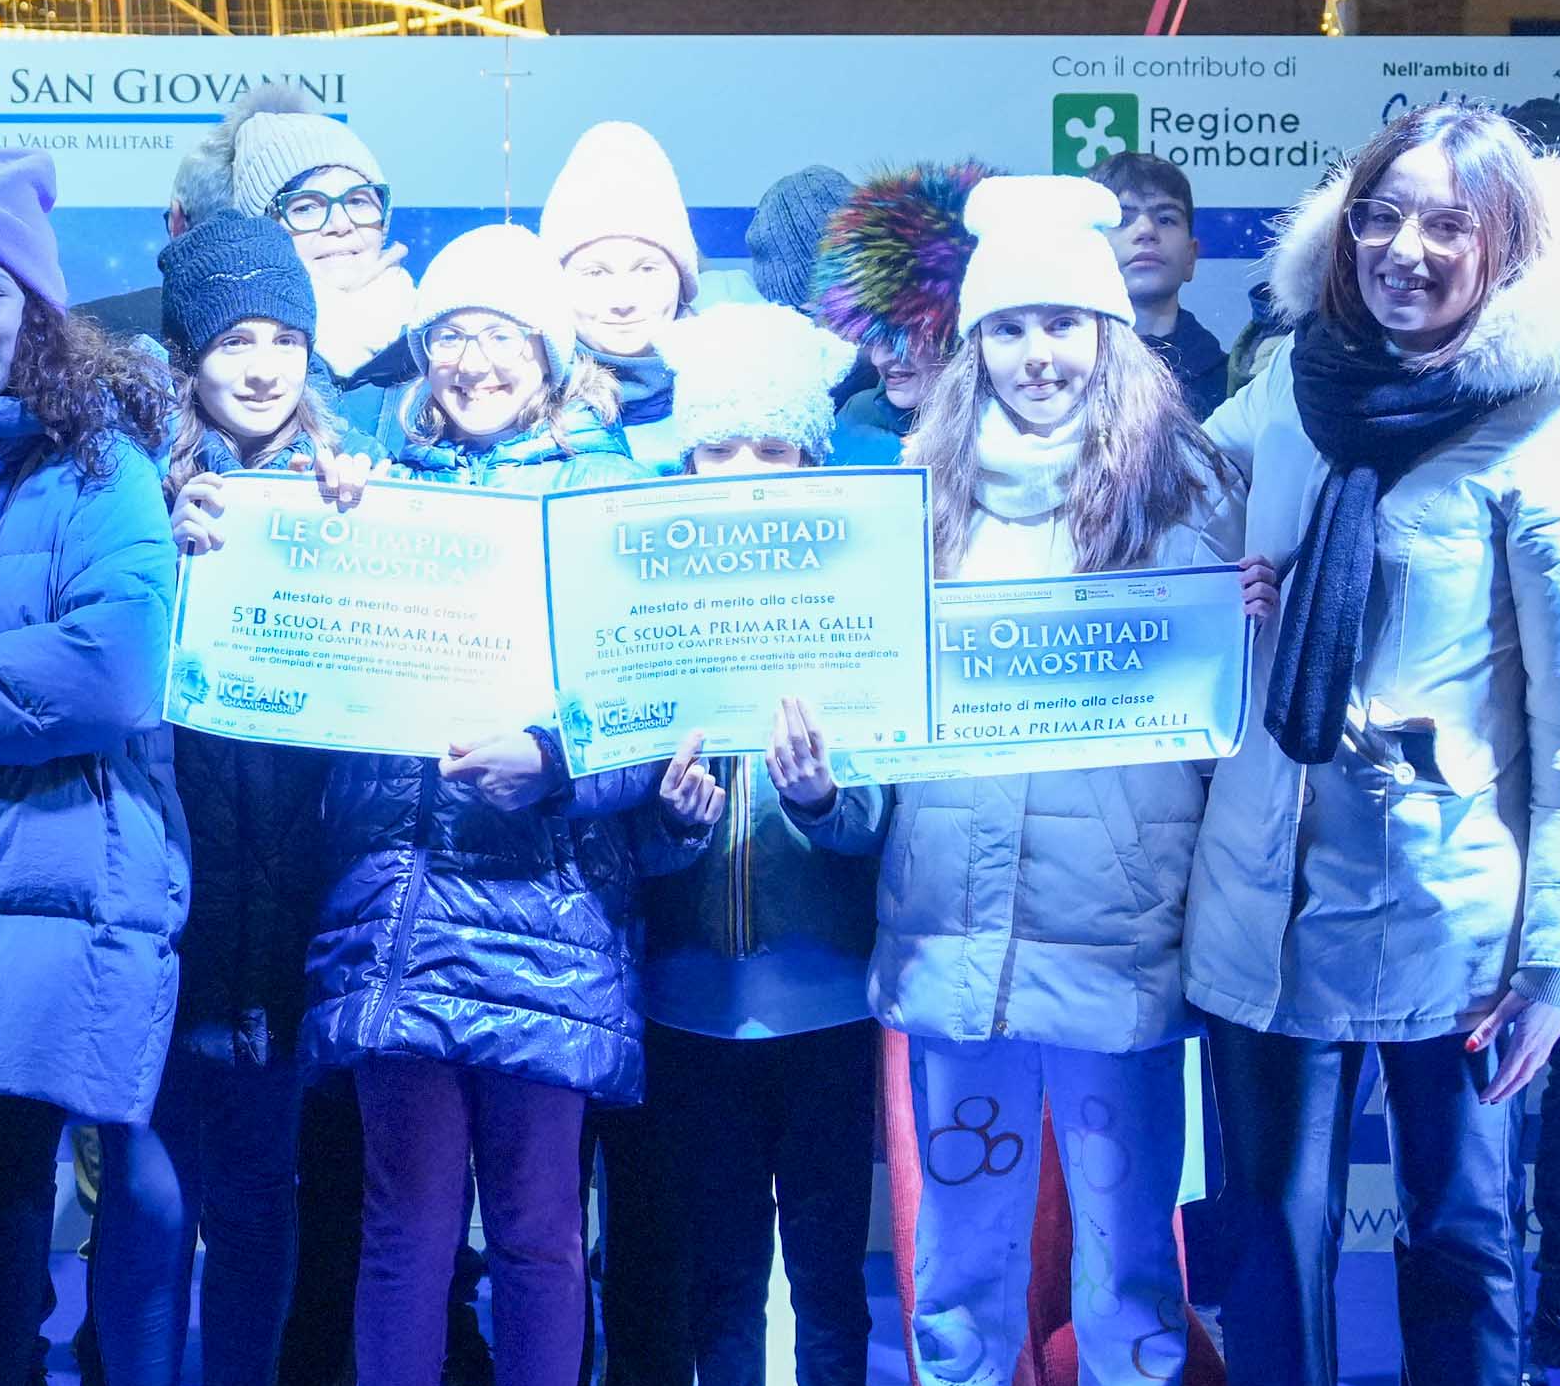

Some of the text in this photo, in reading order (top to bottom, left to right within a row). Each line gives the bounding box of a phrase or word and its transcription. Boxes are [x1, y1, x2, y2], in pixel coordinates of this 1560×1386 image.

[1052, 55, 1297, 77] Con il contributo di
[1493, 61, 1510, 77] di
[10, 69, 96, 104] SAN
[1150, 106, 1301, 140] Regione
[15, 132, 79, 150] VALOR
[86, 133, 174, 150] MILITARE
[617, 517, 847, 555] LE OLIMPIADI
[289, 546, 321, 569] IN
[640, 547, 821, 579] IN MOSTRA
[272, 590, 333, 605] Attestato
[338, 596, 351, 606] di
[355, 599, 399, 612] merito
[630, 593, 836, 616] Attestato di merito alla classe
[274, 613, 342, 632] SCUOLA
[351, 620, 450, 644] PRIMARIA
[634, 624, 702, 642] SCUOLA
[710, 618, 811, 635] PRIMARIA
[819, 616, 874, 630] GALLI
[678, 634, 769, 649] COMPRENSIVO
[774, 634, 826, 644] STATALE
[831, 632, 872, 643] BREDA
[937, 619, 1170, 652] LE OLIMPIADI
[255, 645, 310, 658] partecipato
[963, 649, 1145, 679] IN MOSTRA
[952, 692, 1156, 715] Attestato di merito alla classe
[953, 724, 1021, 740] SCUOLA
[1029, 718, 1127, 735] PRIMARIA
[1135, 713, 1189, 728] GALLI
